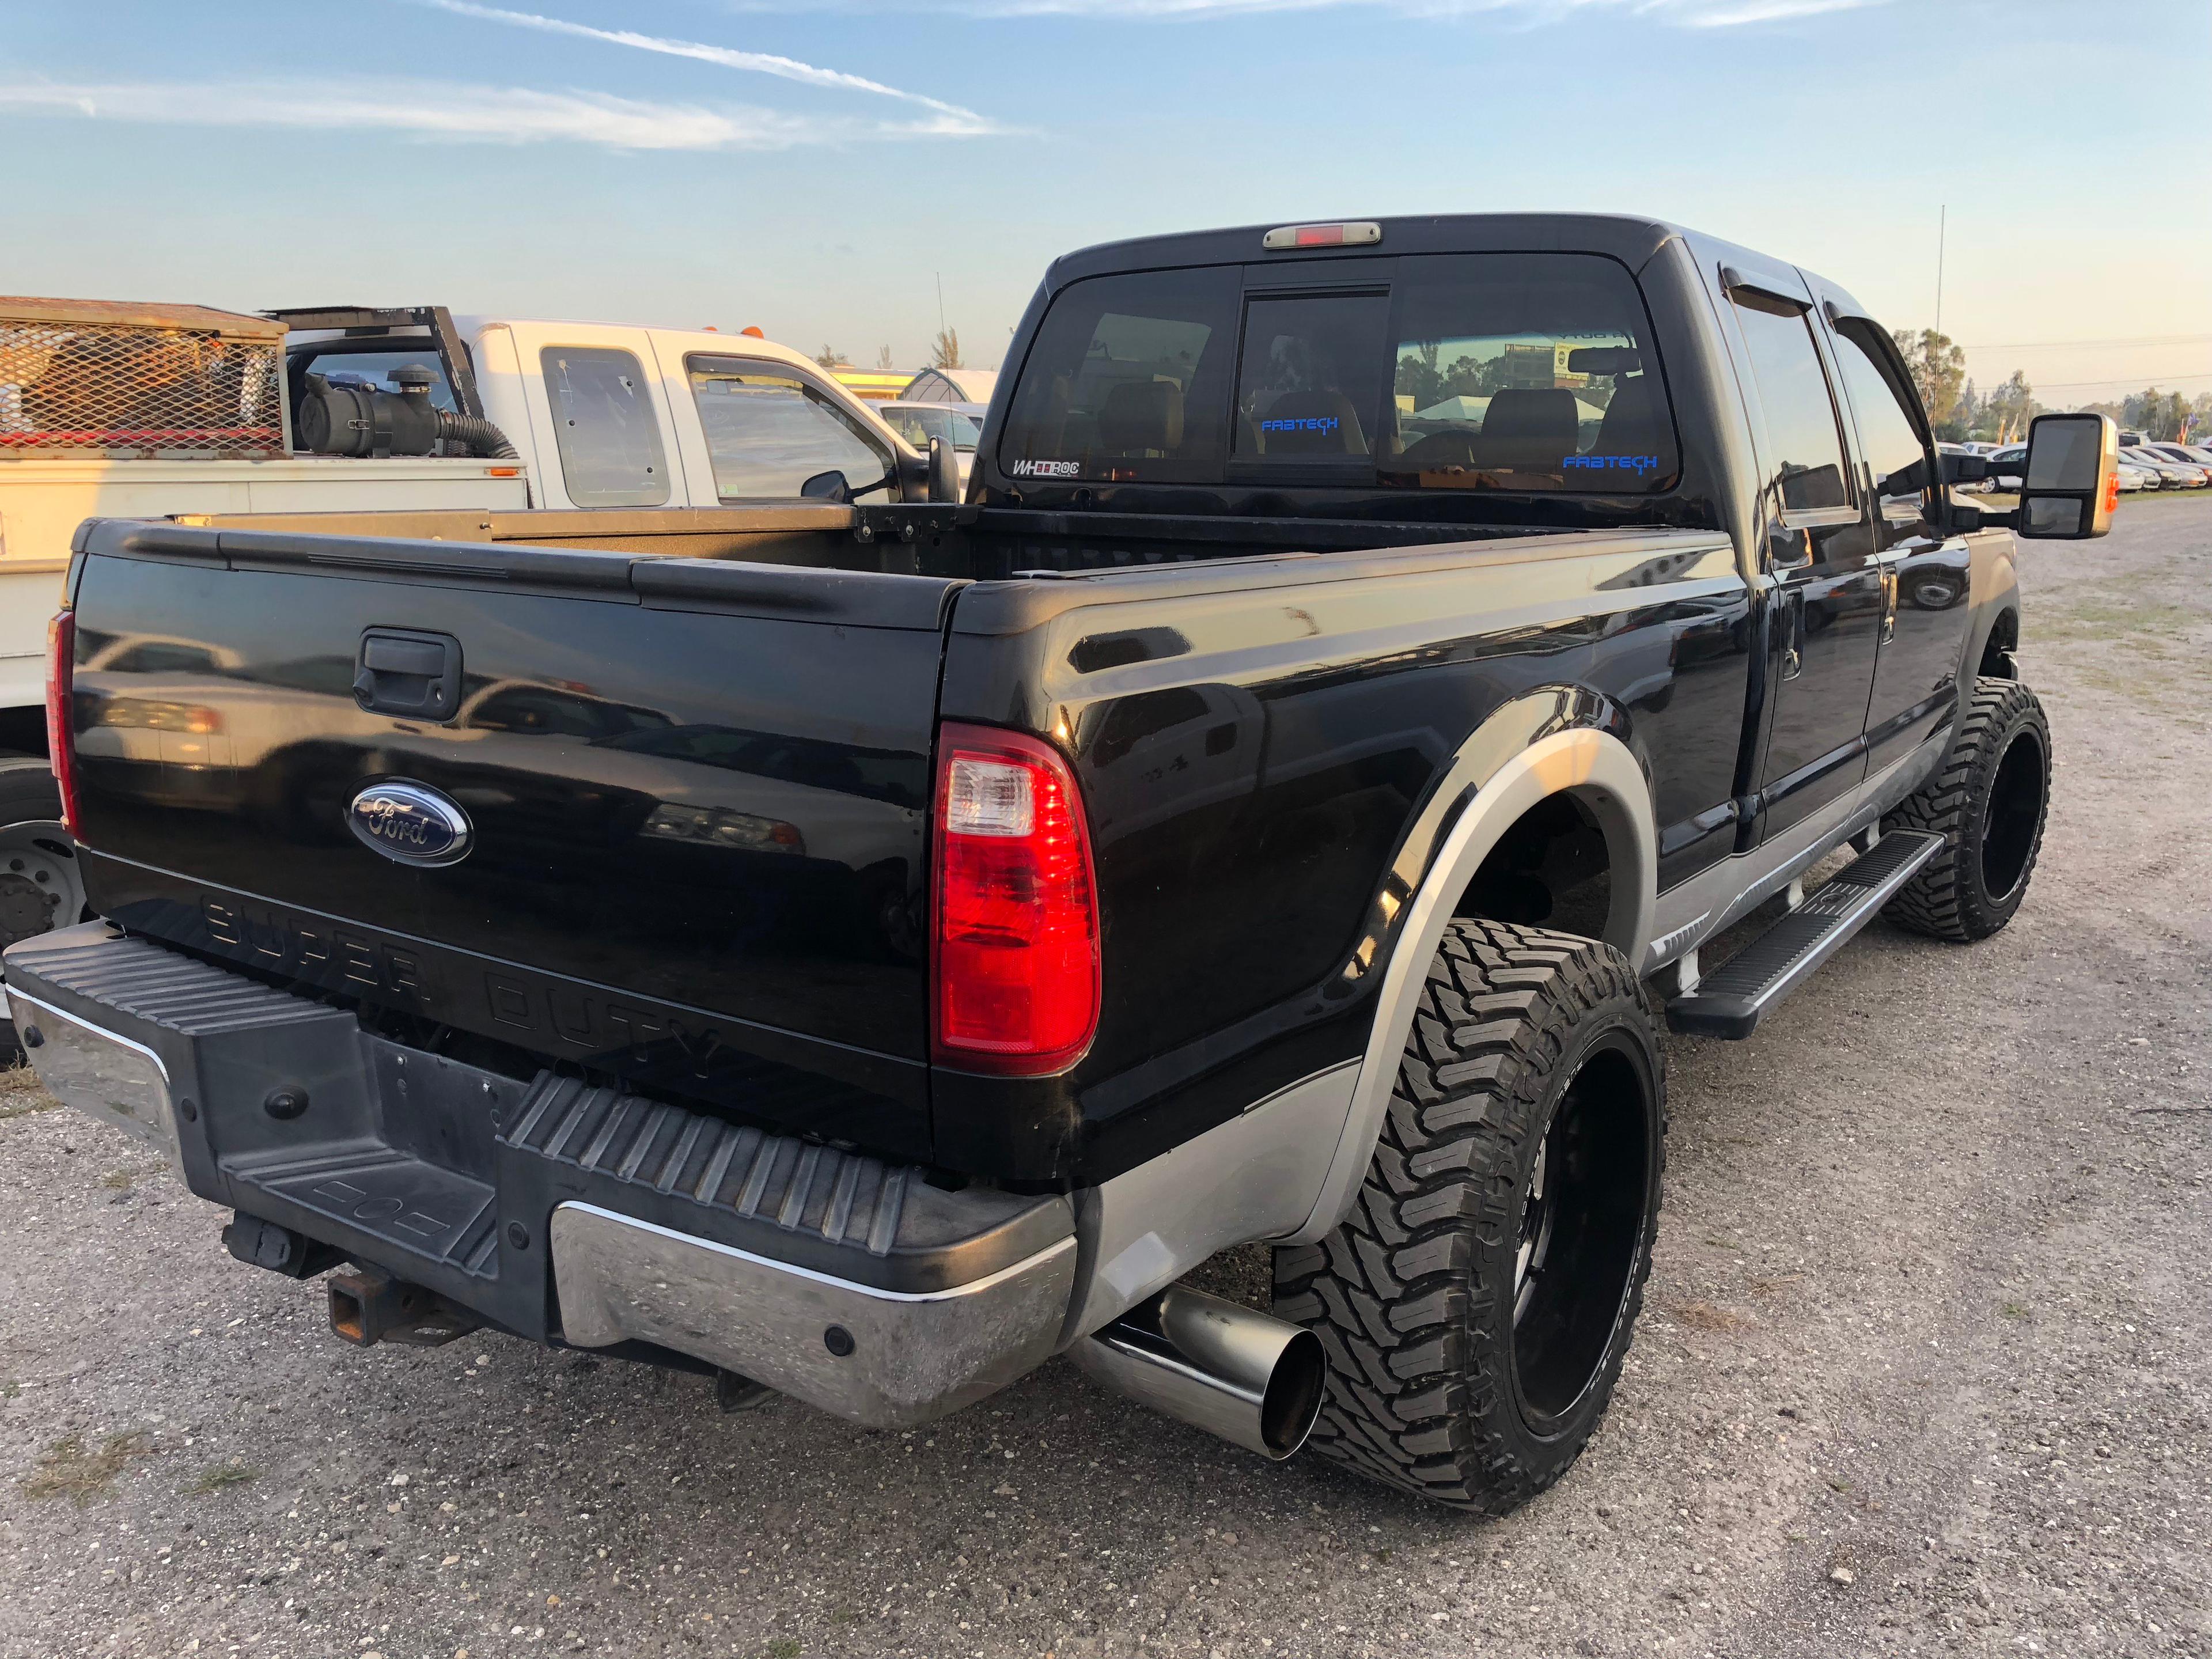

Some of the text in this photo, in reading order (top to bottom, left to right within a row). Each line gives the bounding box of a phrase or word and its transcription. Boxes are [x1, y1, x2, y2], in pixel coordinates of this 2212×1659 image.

[1262, 417, 1338, 435] FABTECH
[1563, 456, 1658, 475] FABTECH
[369, 797, 429, 844] Ford
[199, 893, 720, 1079] SUPER DUTY
